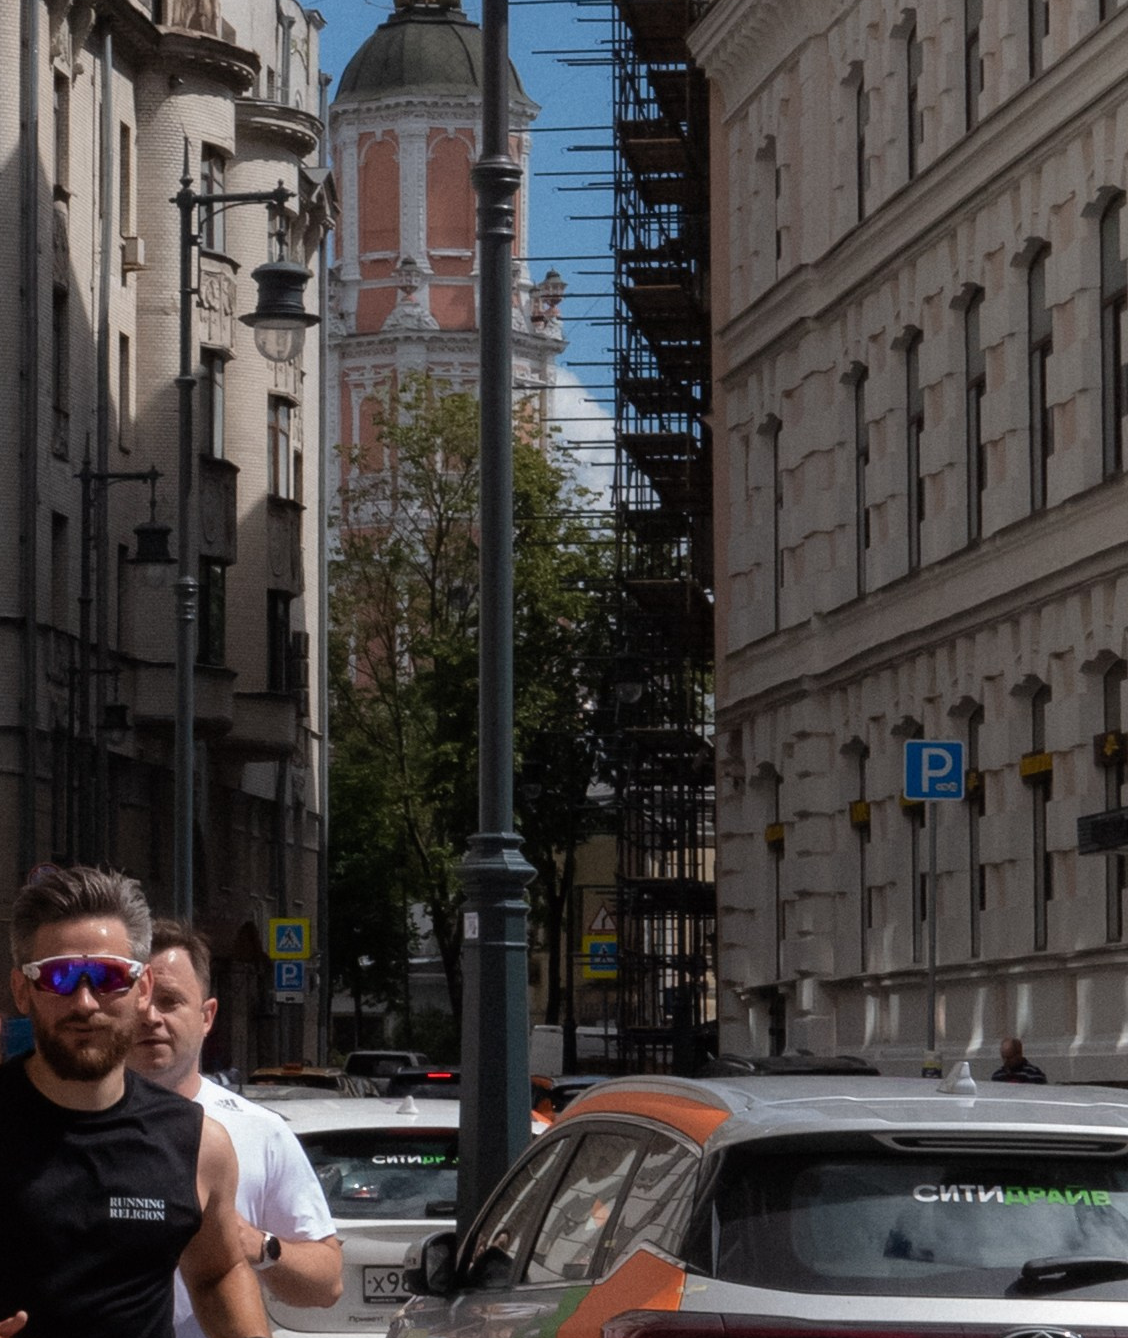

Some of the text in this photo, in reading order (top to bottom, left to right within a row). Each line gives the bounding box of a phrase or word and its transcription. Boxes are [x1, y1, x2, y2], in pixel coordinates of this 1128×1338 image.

[921, 748, 953, 793] P
[109, 1196, 165, 1210] RUNNING
[912, 1184, 1112, 1206] СИТИДРАЙВ
[109, 1208, 165, 1221] RELIGION
